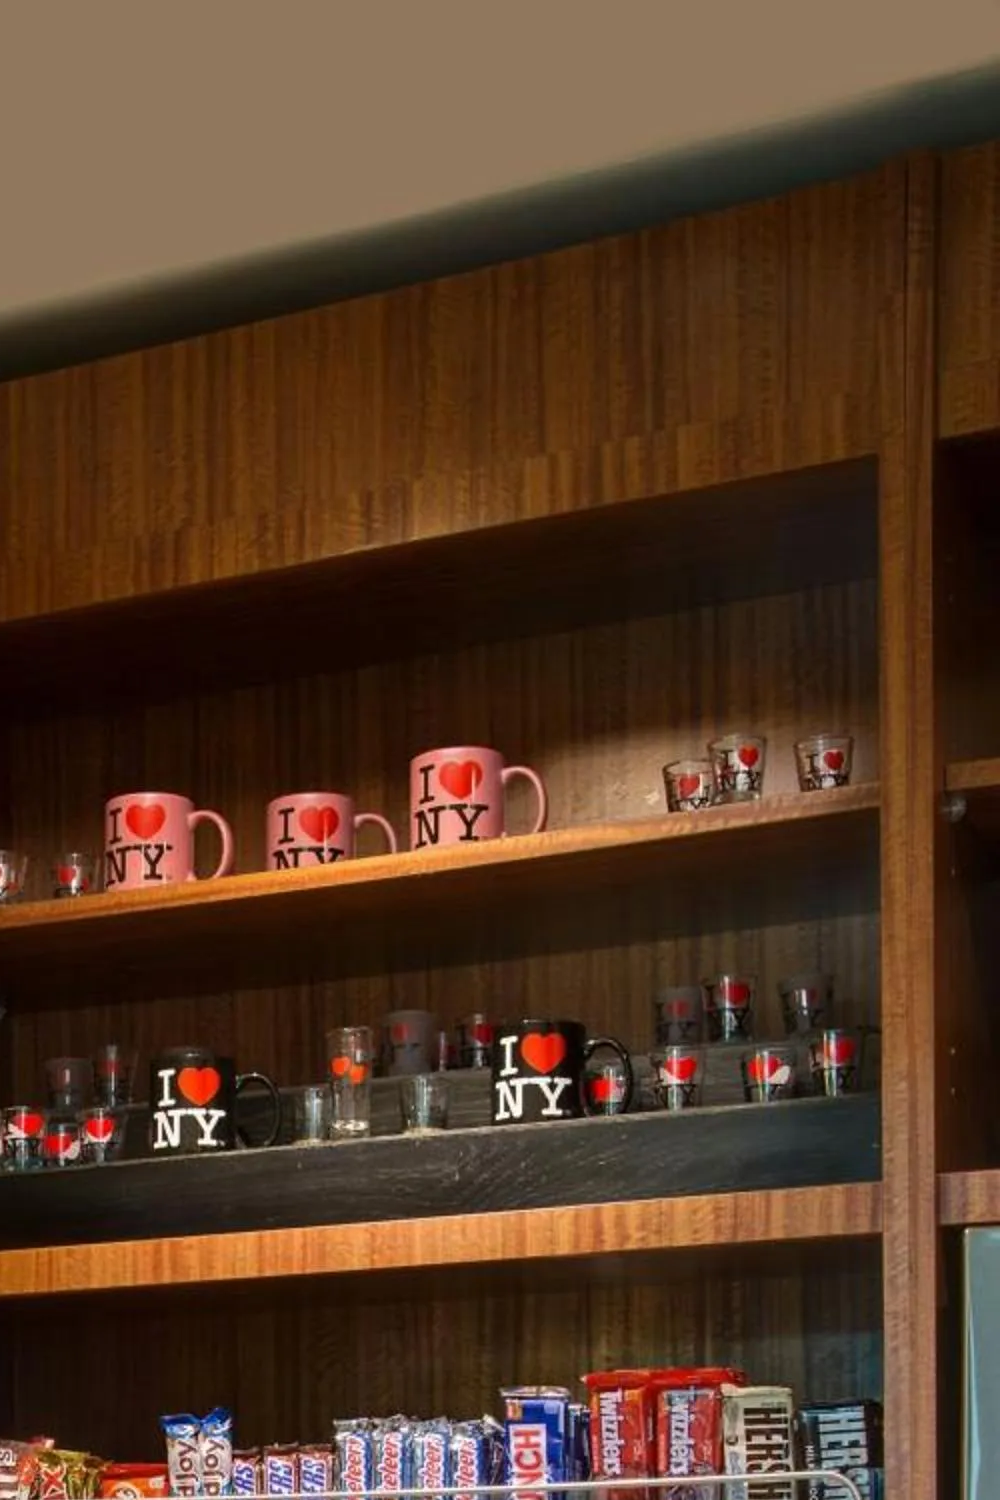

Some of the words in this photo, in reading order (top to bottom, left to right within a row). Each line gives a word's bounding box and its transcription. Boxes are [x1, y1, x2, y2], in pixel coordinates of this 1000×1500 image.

[419, 764, 437, 803] I
[109, 808, 124, 844] I
[279, 807, 295, 844] I
[415, 803, 488, 849] NY
[105, 844, 172, 888] NY
[500, 1035, 519, 1075] I
[158, 1068, 177, 1106] I
[495, 1076, 572, 1121] NY
[153, 1107, 226, 1148] NY
[600, 1387, 624, 1476] Twizzlers
